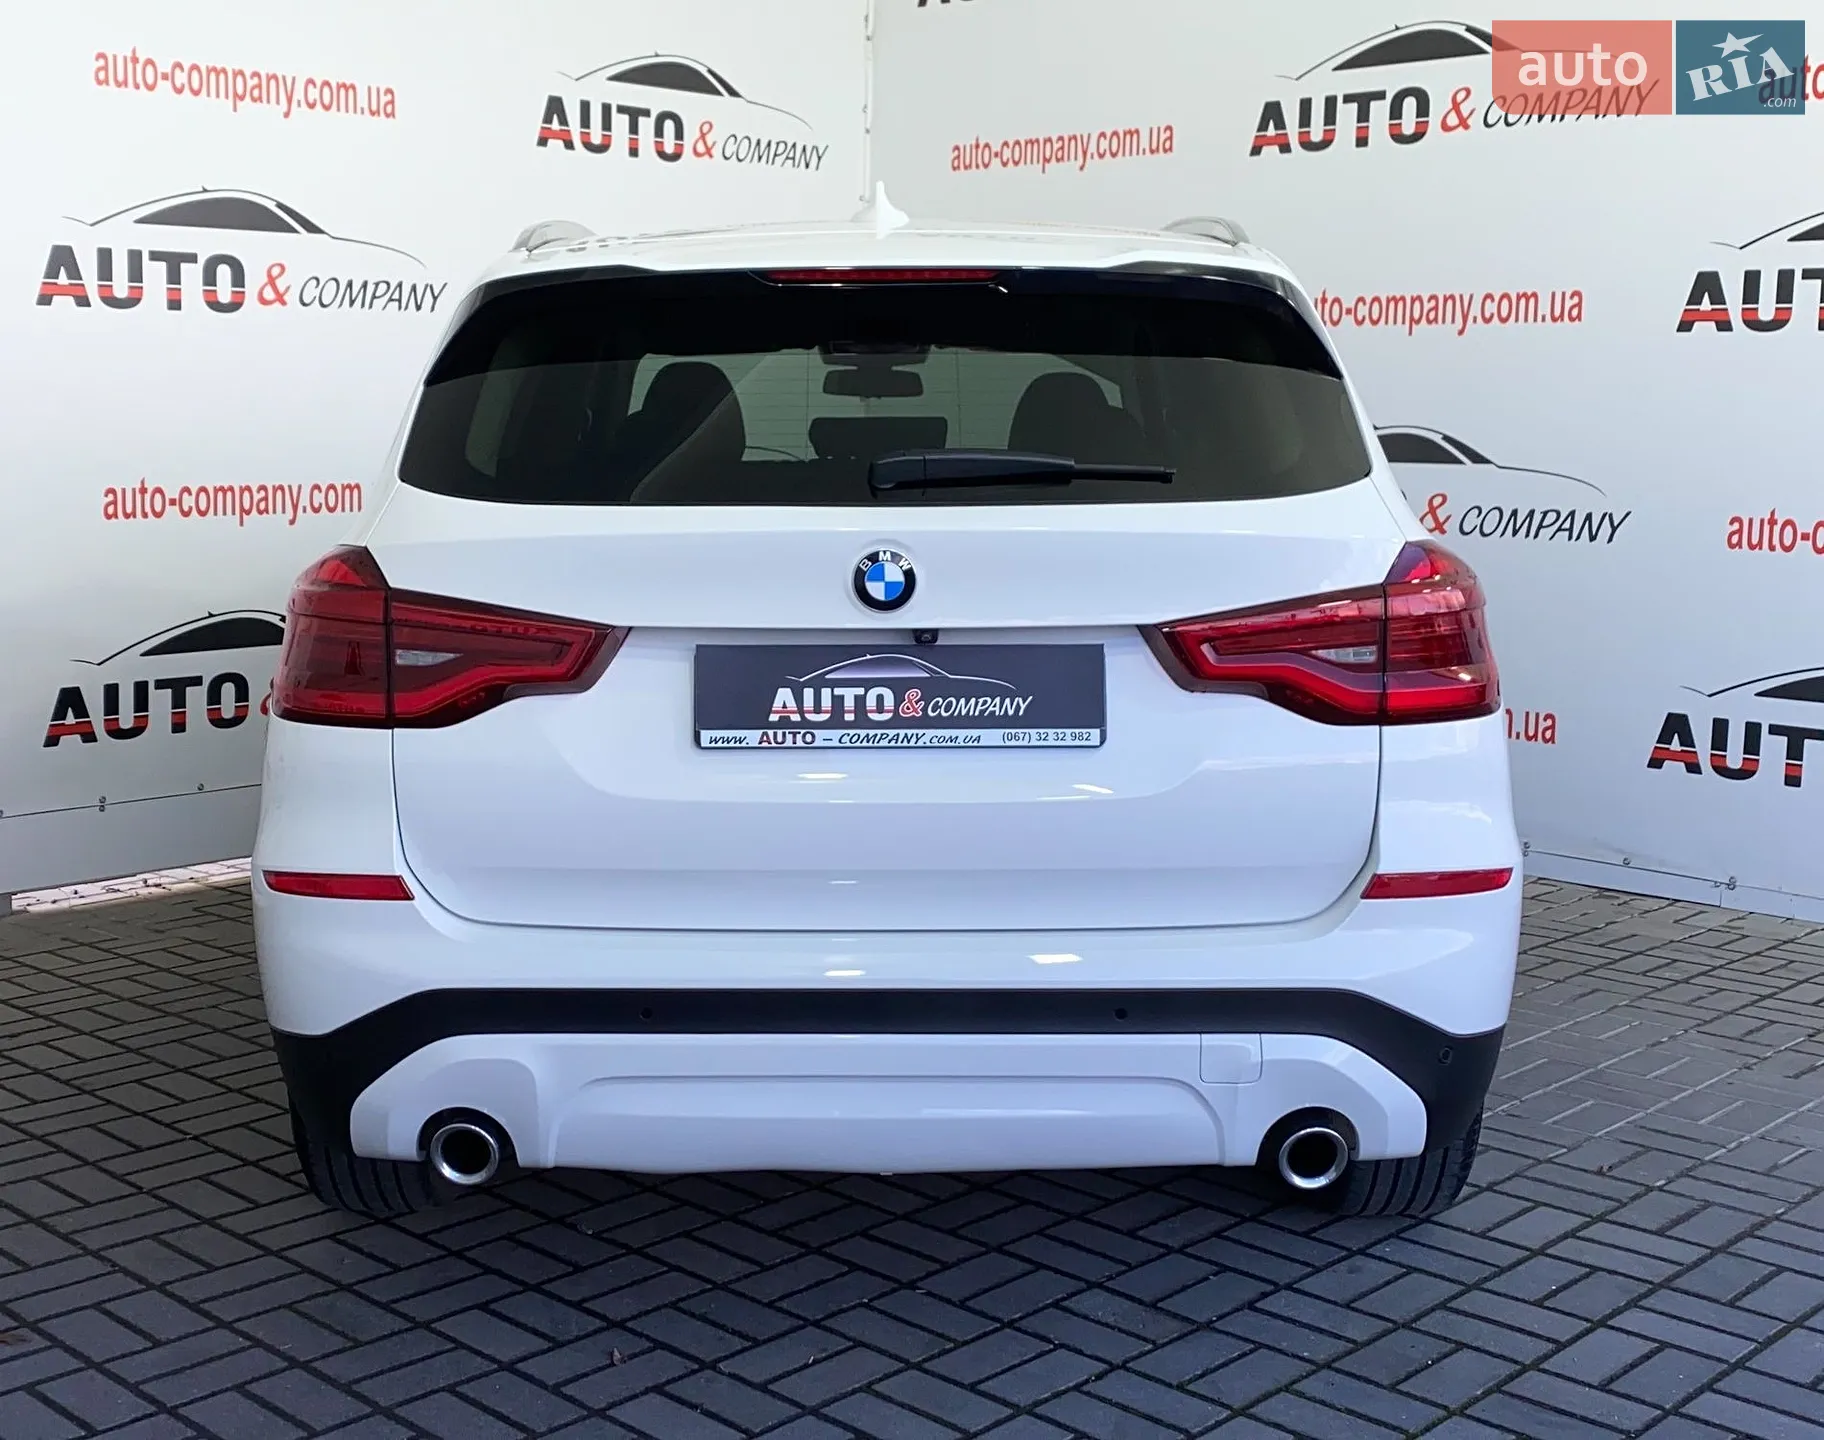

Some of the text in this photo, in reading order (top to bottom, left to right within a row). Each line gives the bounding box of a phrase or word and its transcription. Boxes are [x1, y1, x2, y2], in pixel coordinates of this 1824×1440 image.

[94, 47, 396, 118] auto-company.com.ua
[537, 95, 829, 172] AUTO & COMPANY
[1249, 78, 1660, 156] AUTO & COMPANY
[951, 124, 1174, 174] auto-company.com.ua
[36, 245, 448, 314] AUTO & COMPANY
[1314, 288, 1584, 336] to-company.com.ua
[103, 477, 361, 526] auto-company.com
[1419, 493, 1632, 544] & COMPANY
[859, 550, 912, 571] BMW
[43, 672, 250, 748] AUTO
[768, 687, 1033, 722] AUTO & COMPANY
[757, 731, 816, 746] AUTO
[1002, 732, 1031, 743] (067)
[1035, 732, 1049, 742] 32
[1053, 732, 1066, 742] 32
[1070, 732, 1091, 742] 982
